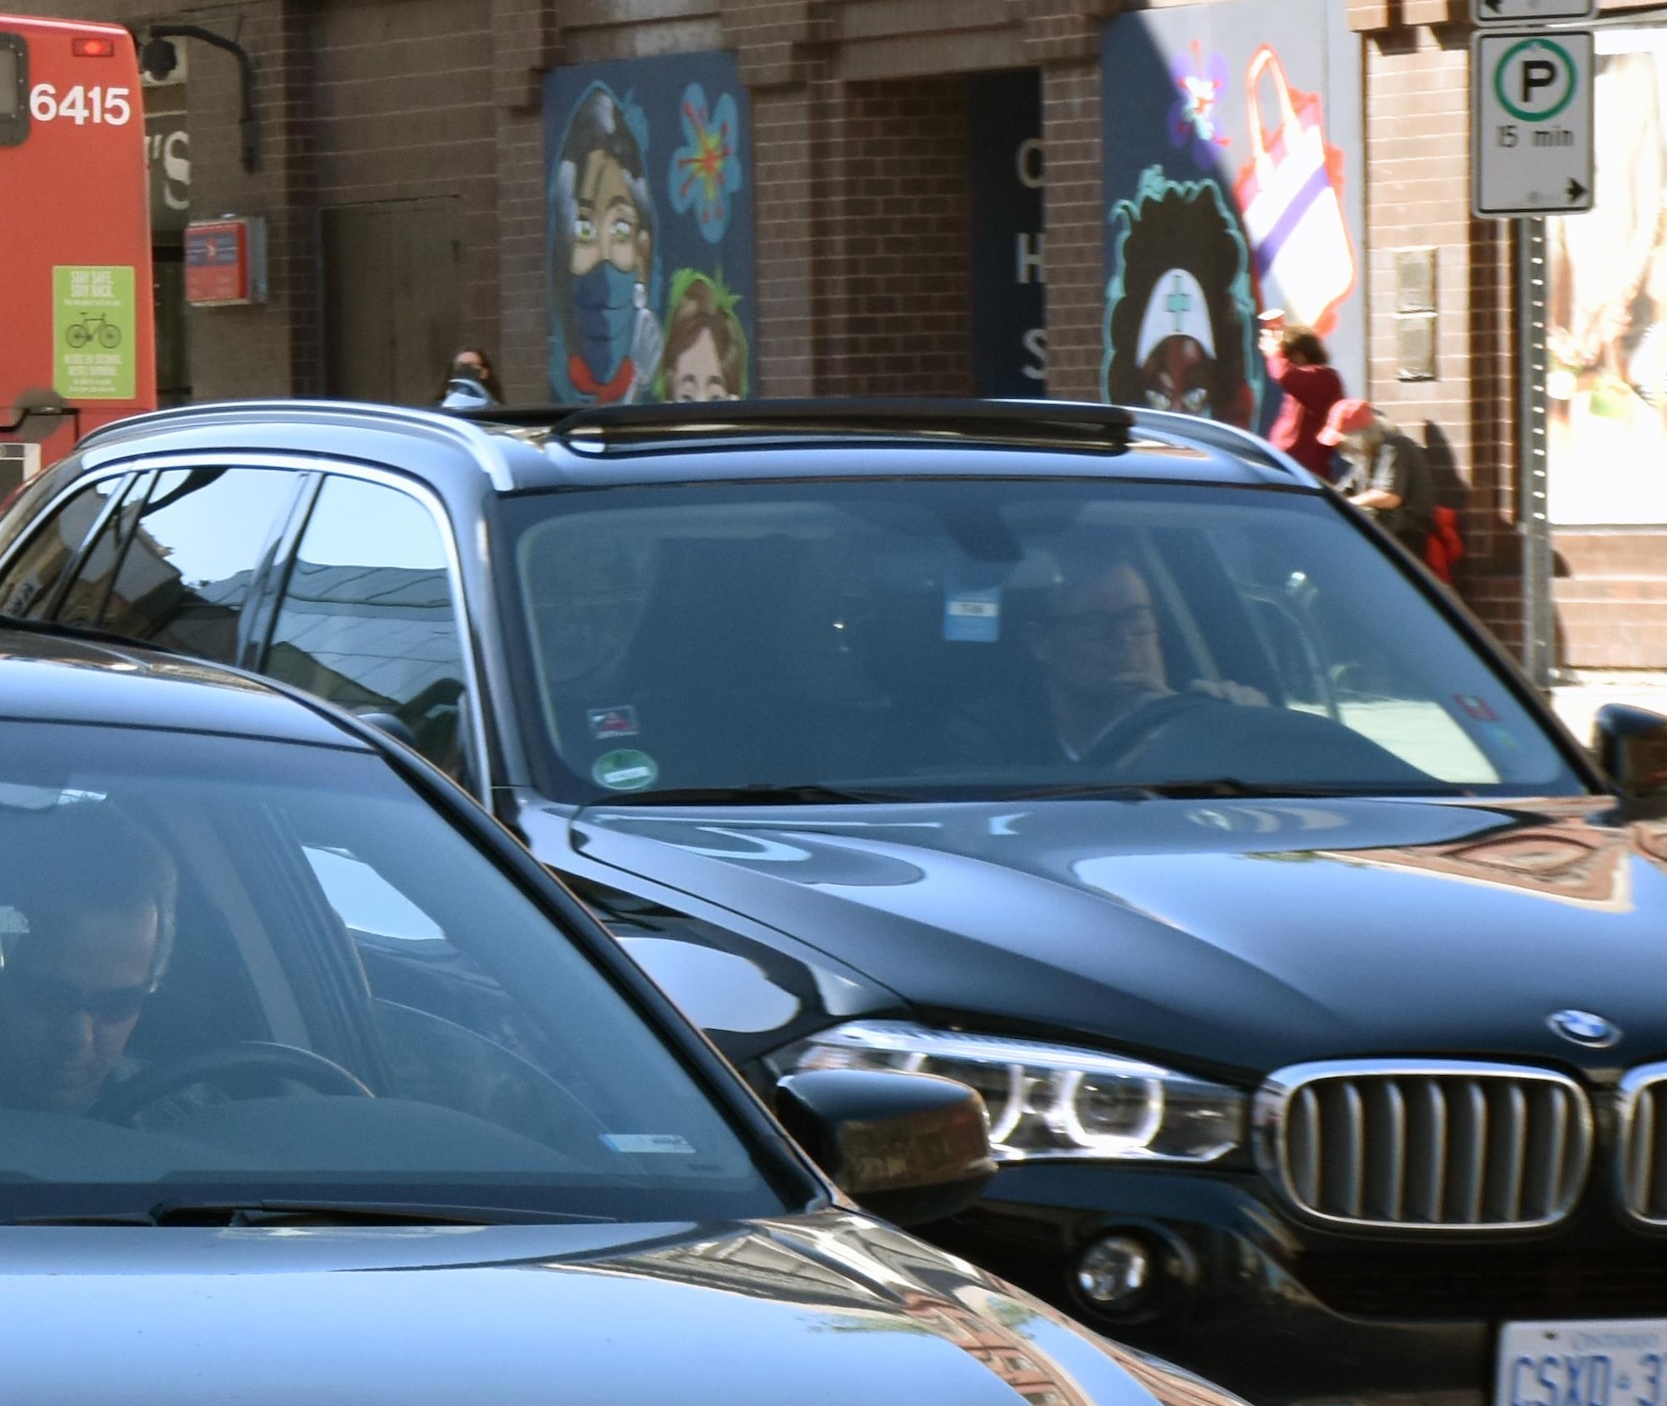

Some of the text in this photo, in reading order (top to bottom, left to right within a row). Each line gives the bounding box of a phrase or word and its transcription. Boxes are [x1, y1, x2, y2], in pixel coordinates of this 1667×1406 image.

[29, 83, 131, 126] 6415
[1496, 125, 1574, 148] 15 min
